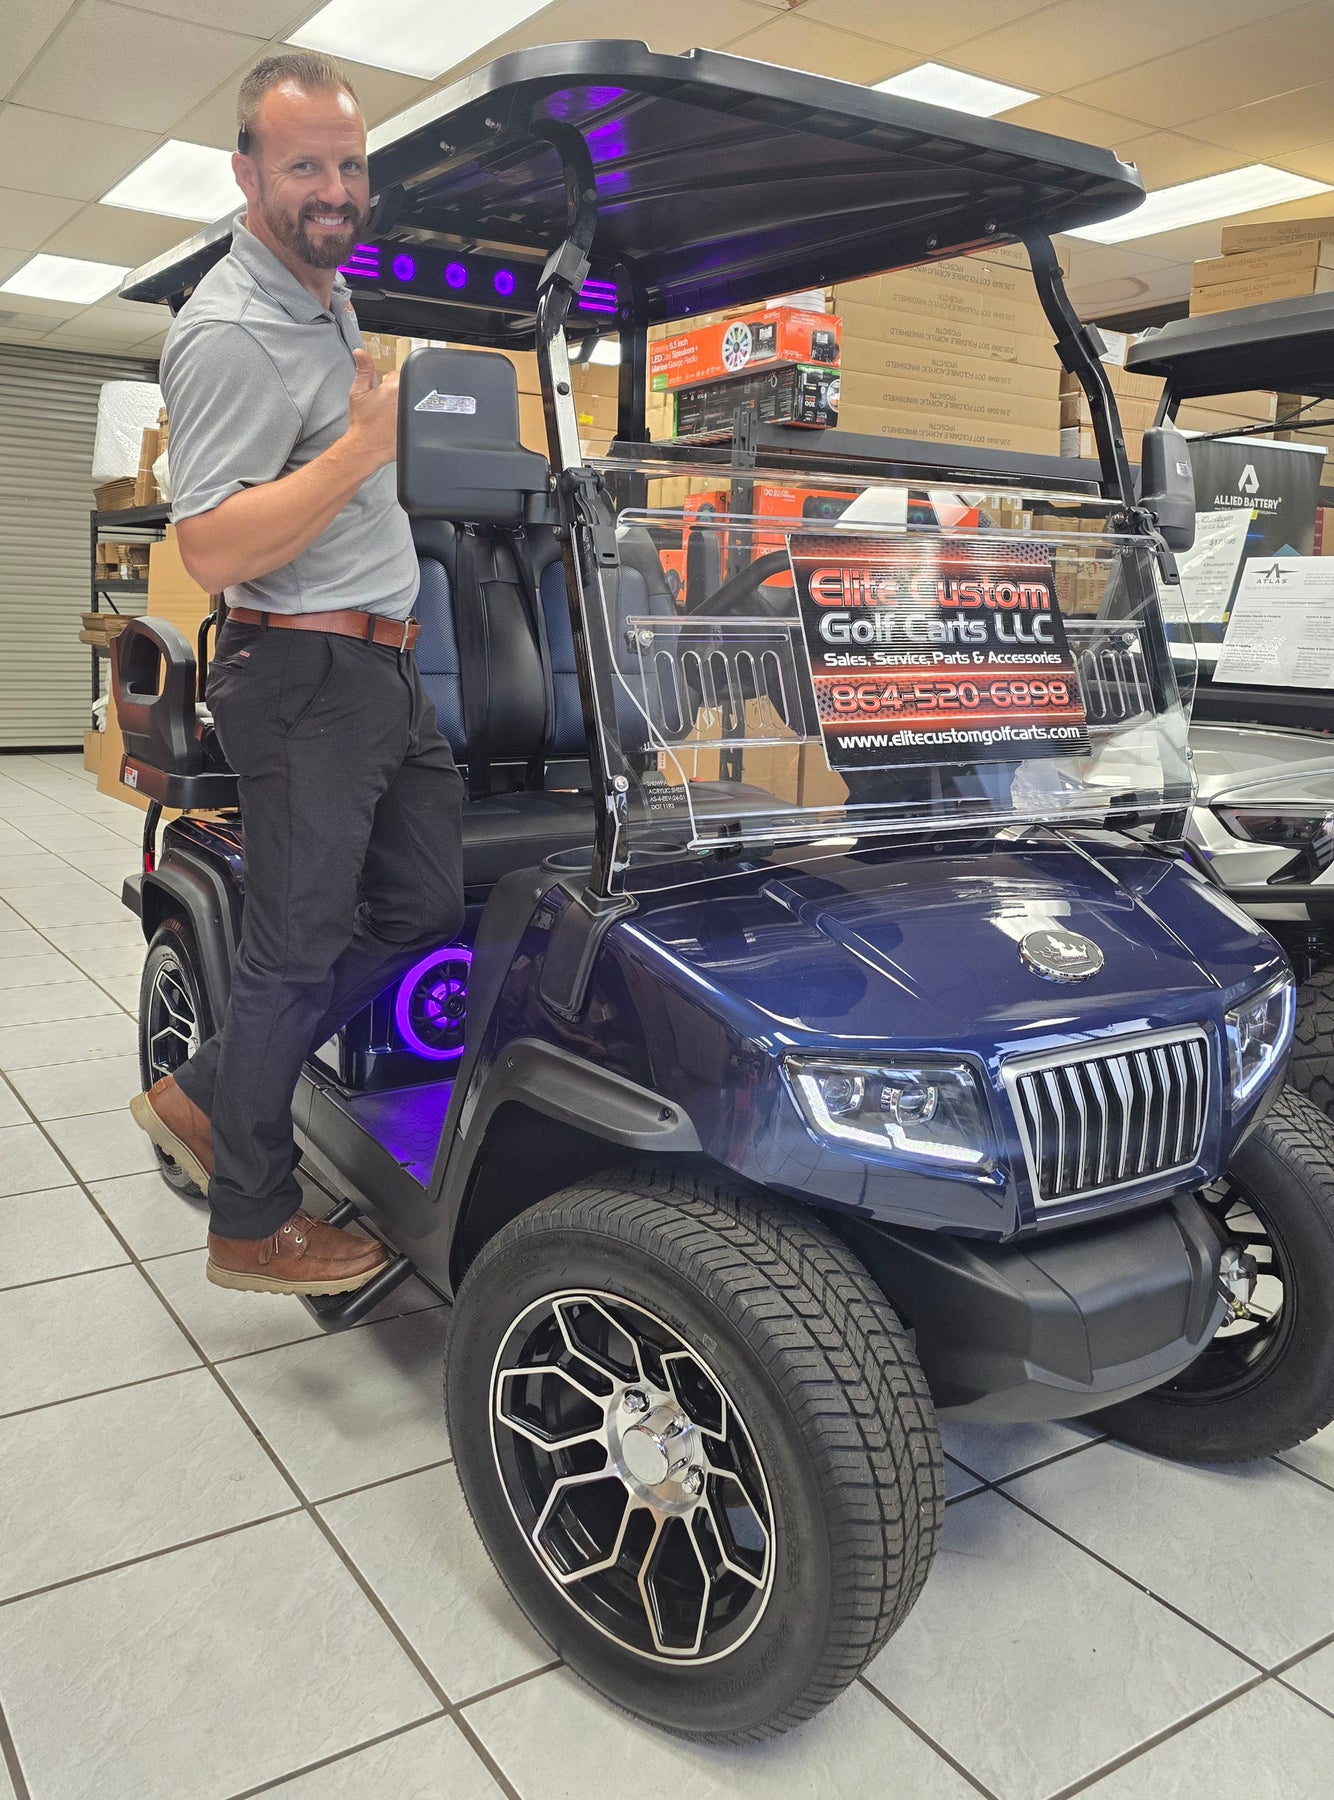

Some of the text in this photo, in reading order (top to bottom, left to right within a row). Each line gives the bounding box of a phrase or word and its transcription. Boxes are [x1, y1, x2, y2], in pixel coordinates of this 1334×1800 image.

[928, 268, 951, 280] ACRYLIC
[952, 273, 979, 285] FOLDABLE
[979, 278, 990, 287] DOT
[892, 294, 927, 307] WINDSHIELD
[928, 300, 951, 311] ACRYLIC
[951, 305, 979, 316] FOLDABLE
[980, 310, 991, 318] DOT
[890, 328, 924, 339] WINDSHIELD
[925, 333, 949, 344] ACRYLIC
[949, 337, 978, 349] FOLDABLE
[979, 342, 990, 351] DOT
[886, 361, 921, 372] WINDSHIELD
[920, 365, 944, 375] ACRYLIC
[945, 368, 974, 380] FOLDABLE
[975, 373, 986, 381] DOT
[883, 394, 918, 405] WINDSHIELD
[919, 398, 943, 408] ACRYLIC
[944, 401, 973, 412] FOLDABLE
[974, 405, 985, 413] DOT
[882, 425, 918, 436] WINDSHIELD
[918, 429, 943, 439] ACRYLIC
[944, 431, 973, 442] FOLDABLE
[974, 435, 985, 443] DOT
[1214, 495, 1243, 506] ALLIED
[809, 568, 900, 608] Elite
[910, 574, 1050, 610] Custom
[819, 611, 1054, 644] Golf Carts LLC
[824, 651, 1062, 667] Sales, Service, Parts & Accessories
[830, 680, 1070, 712] 864-520-6898
[838, 726, 1080, 749] www.elitecustomgolfcarts.com
